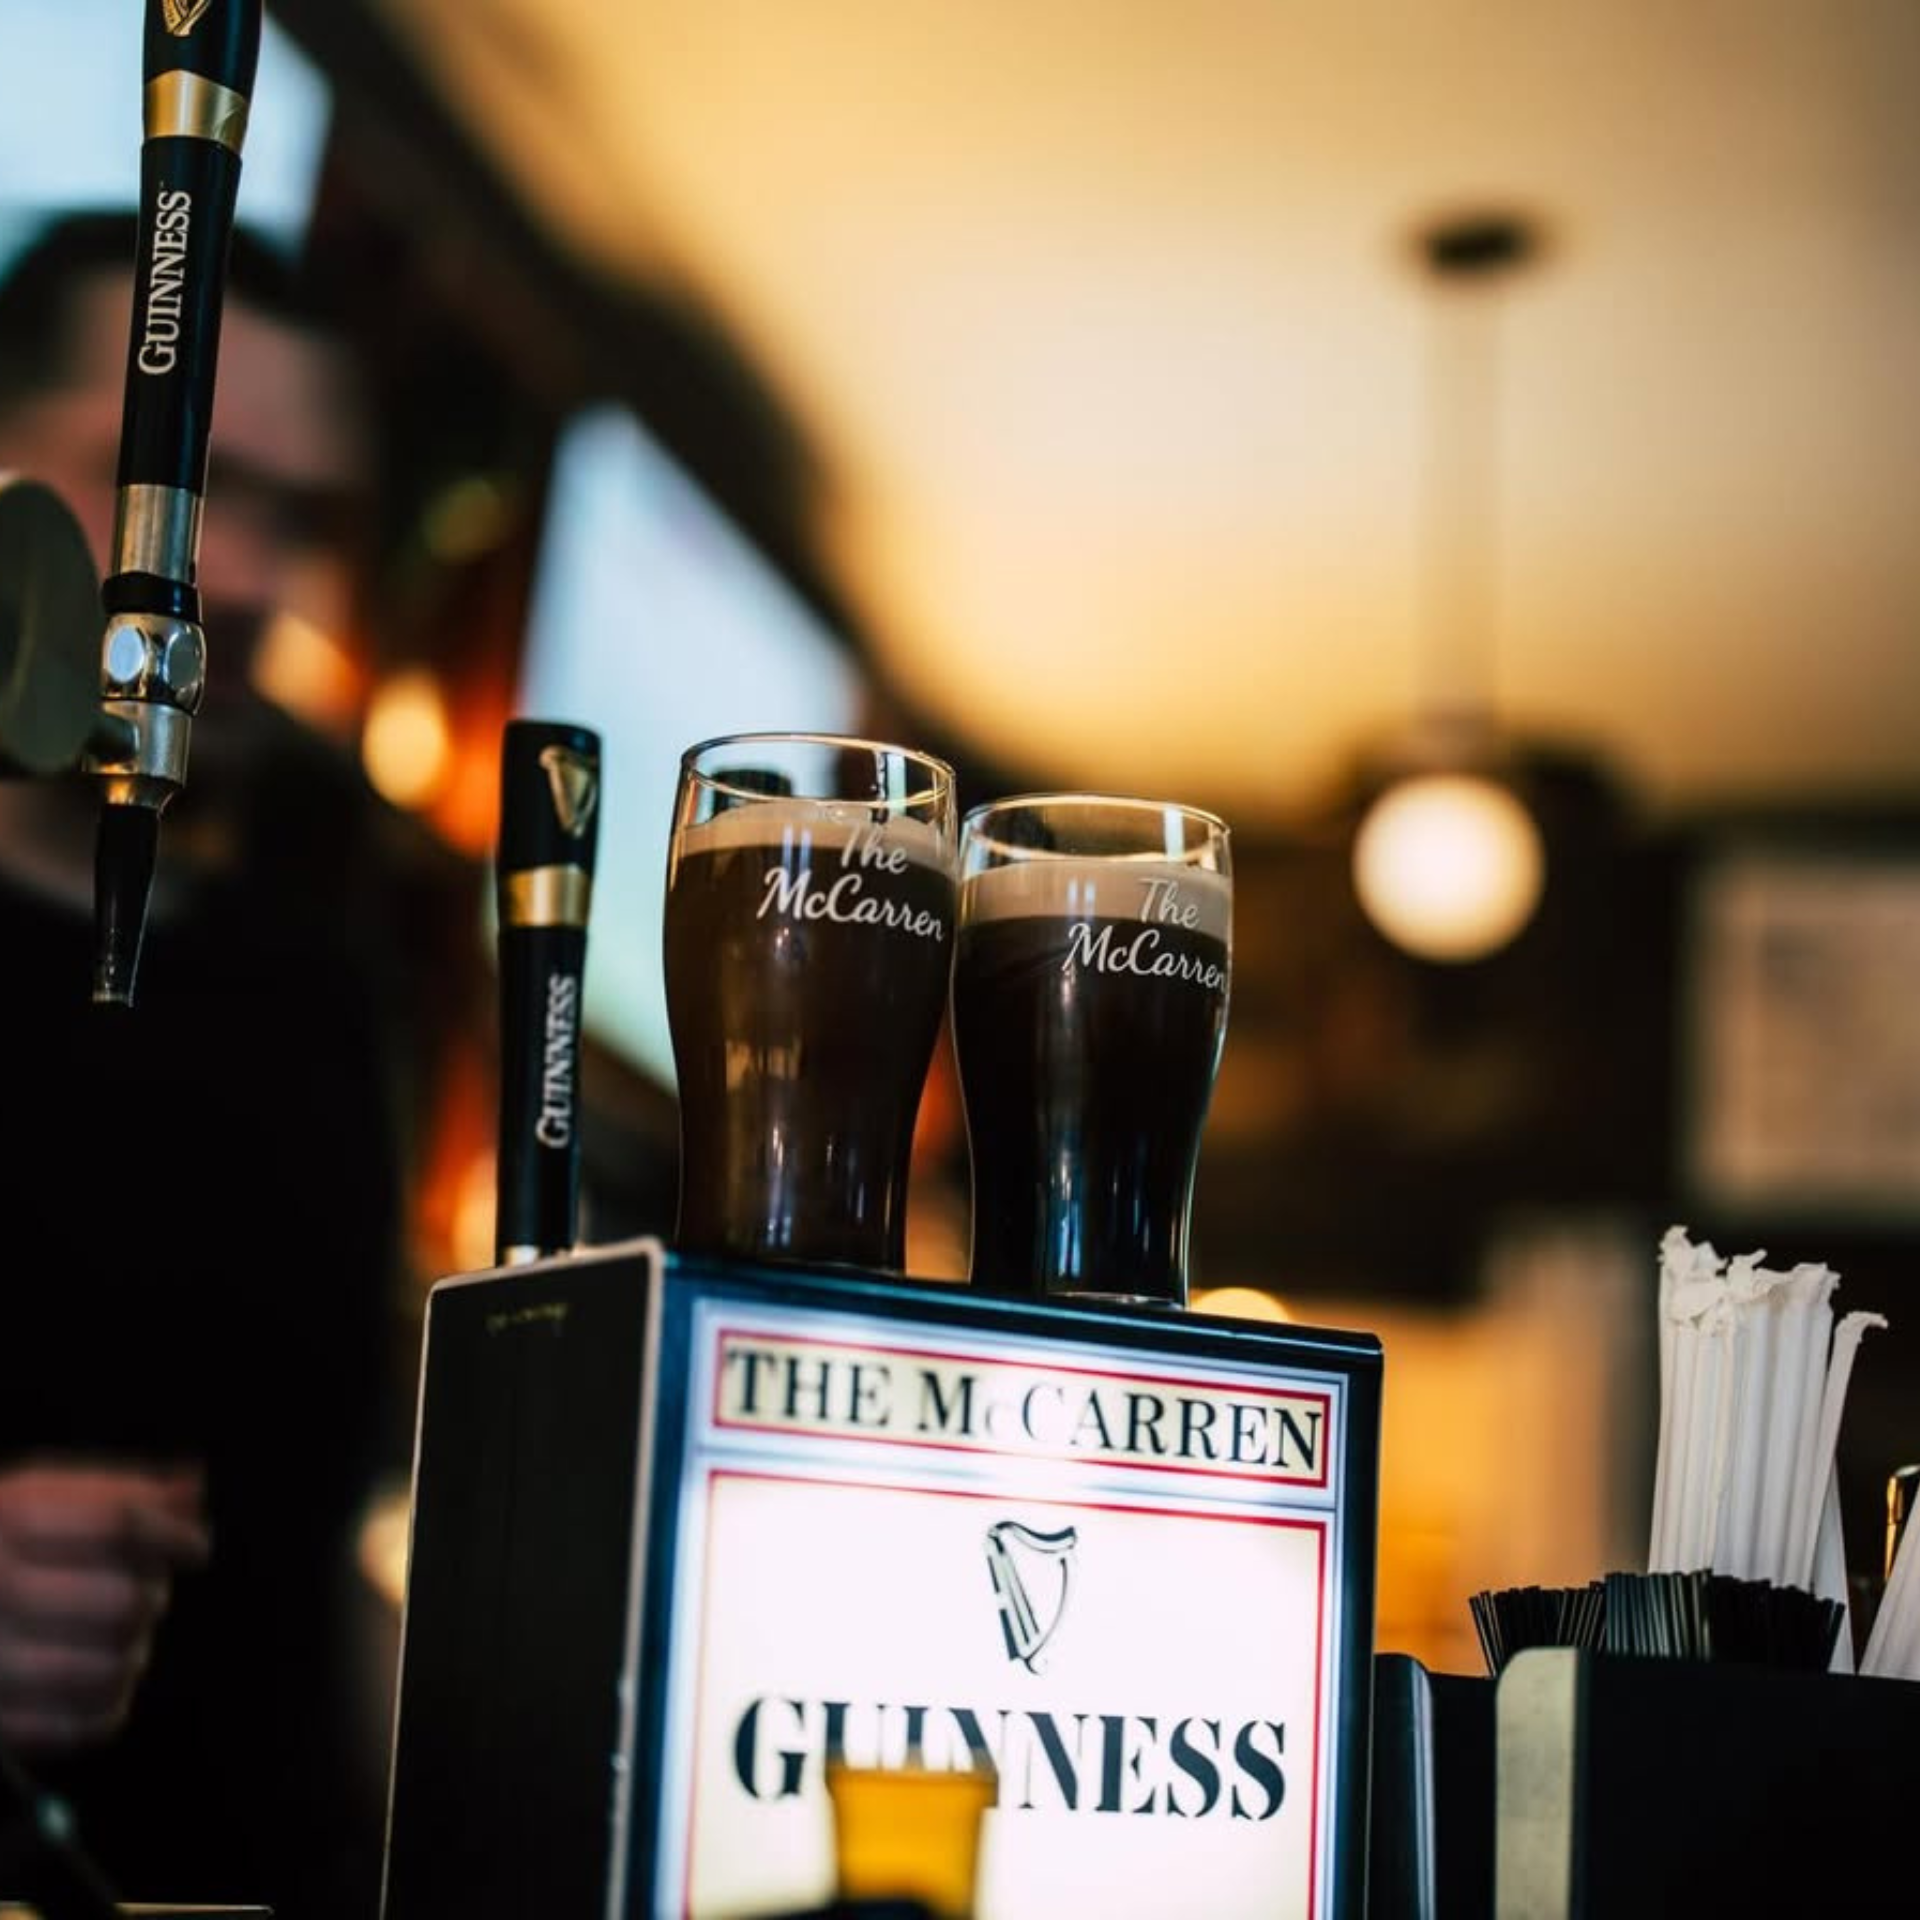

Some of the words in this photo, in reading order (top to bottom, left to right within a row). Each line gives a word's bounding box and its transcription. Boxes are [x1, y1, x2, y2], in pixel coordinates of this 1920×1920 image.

[137, 190, 192, 375] GUINNESS
[837, 822, 910, 875] The
[756, 866, 945, 943] McCarren
[1137, 876, 1200, 930] The
[1061, 922, 1227, 993] McCarren
[535, 973, 577, 1149] GUINNESS
[726, 1346, 892, 1428] THE
